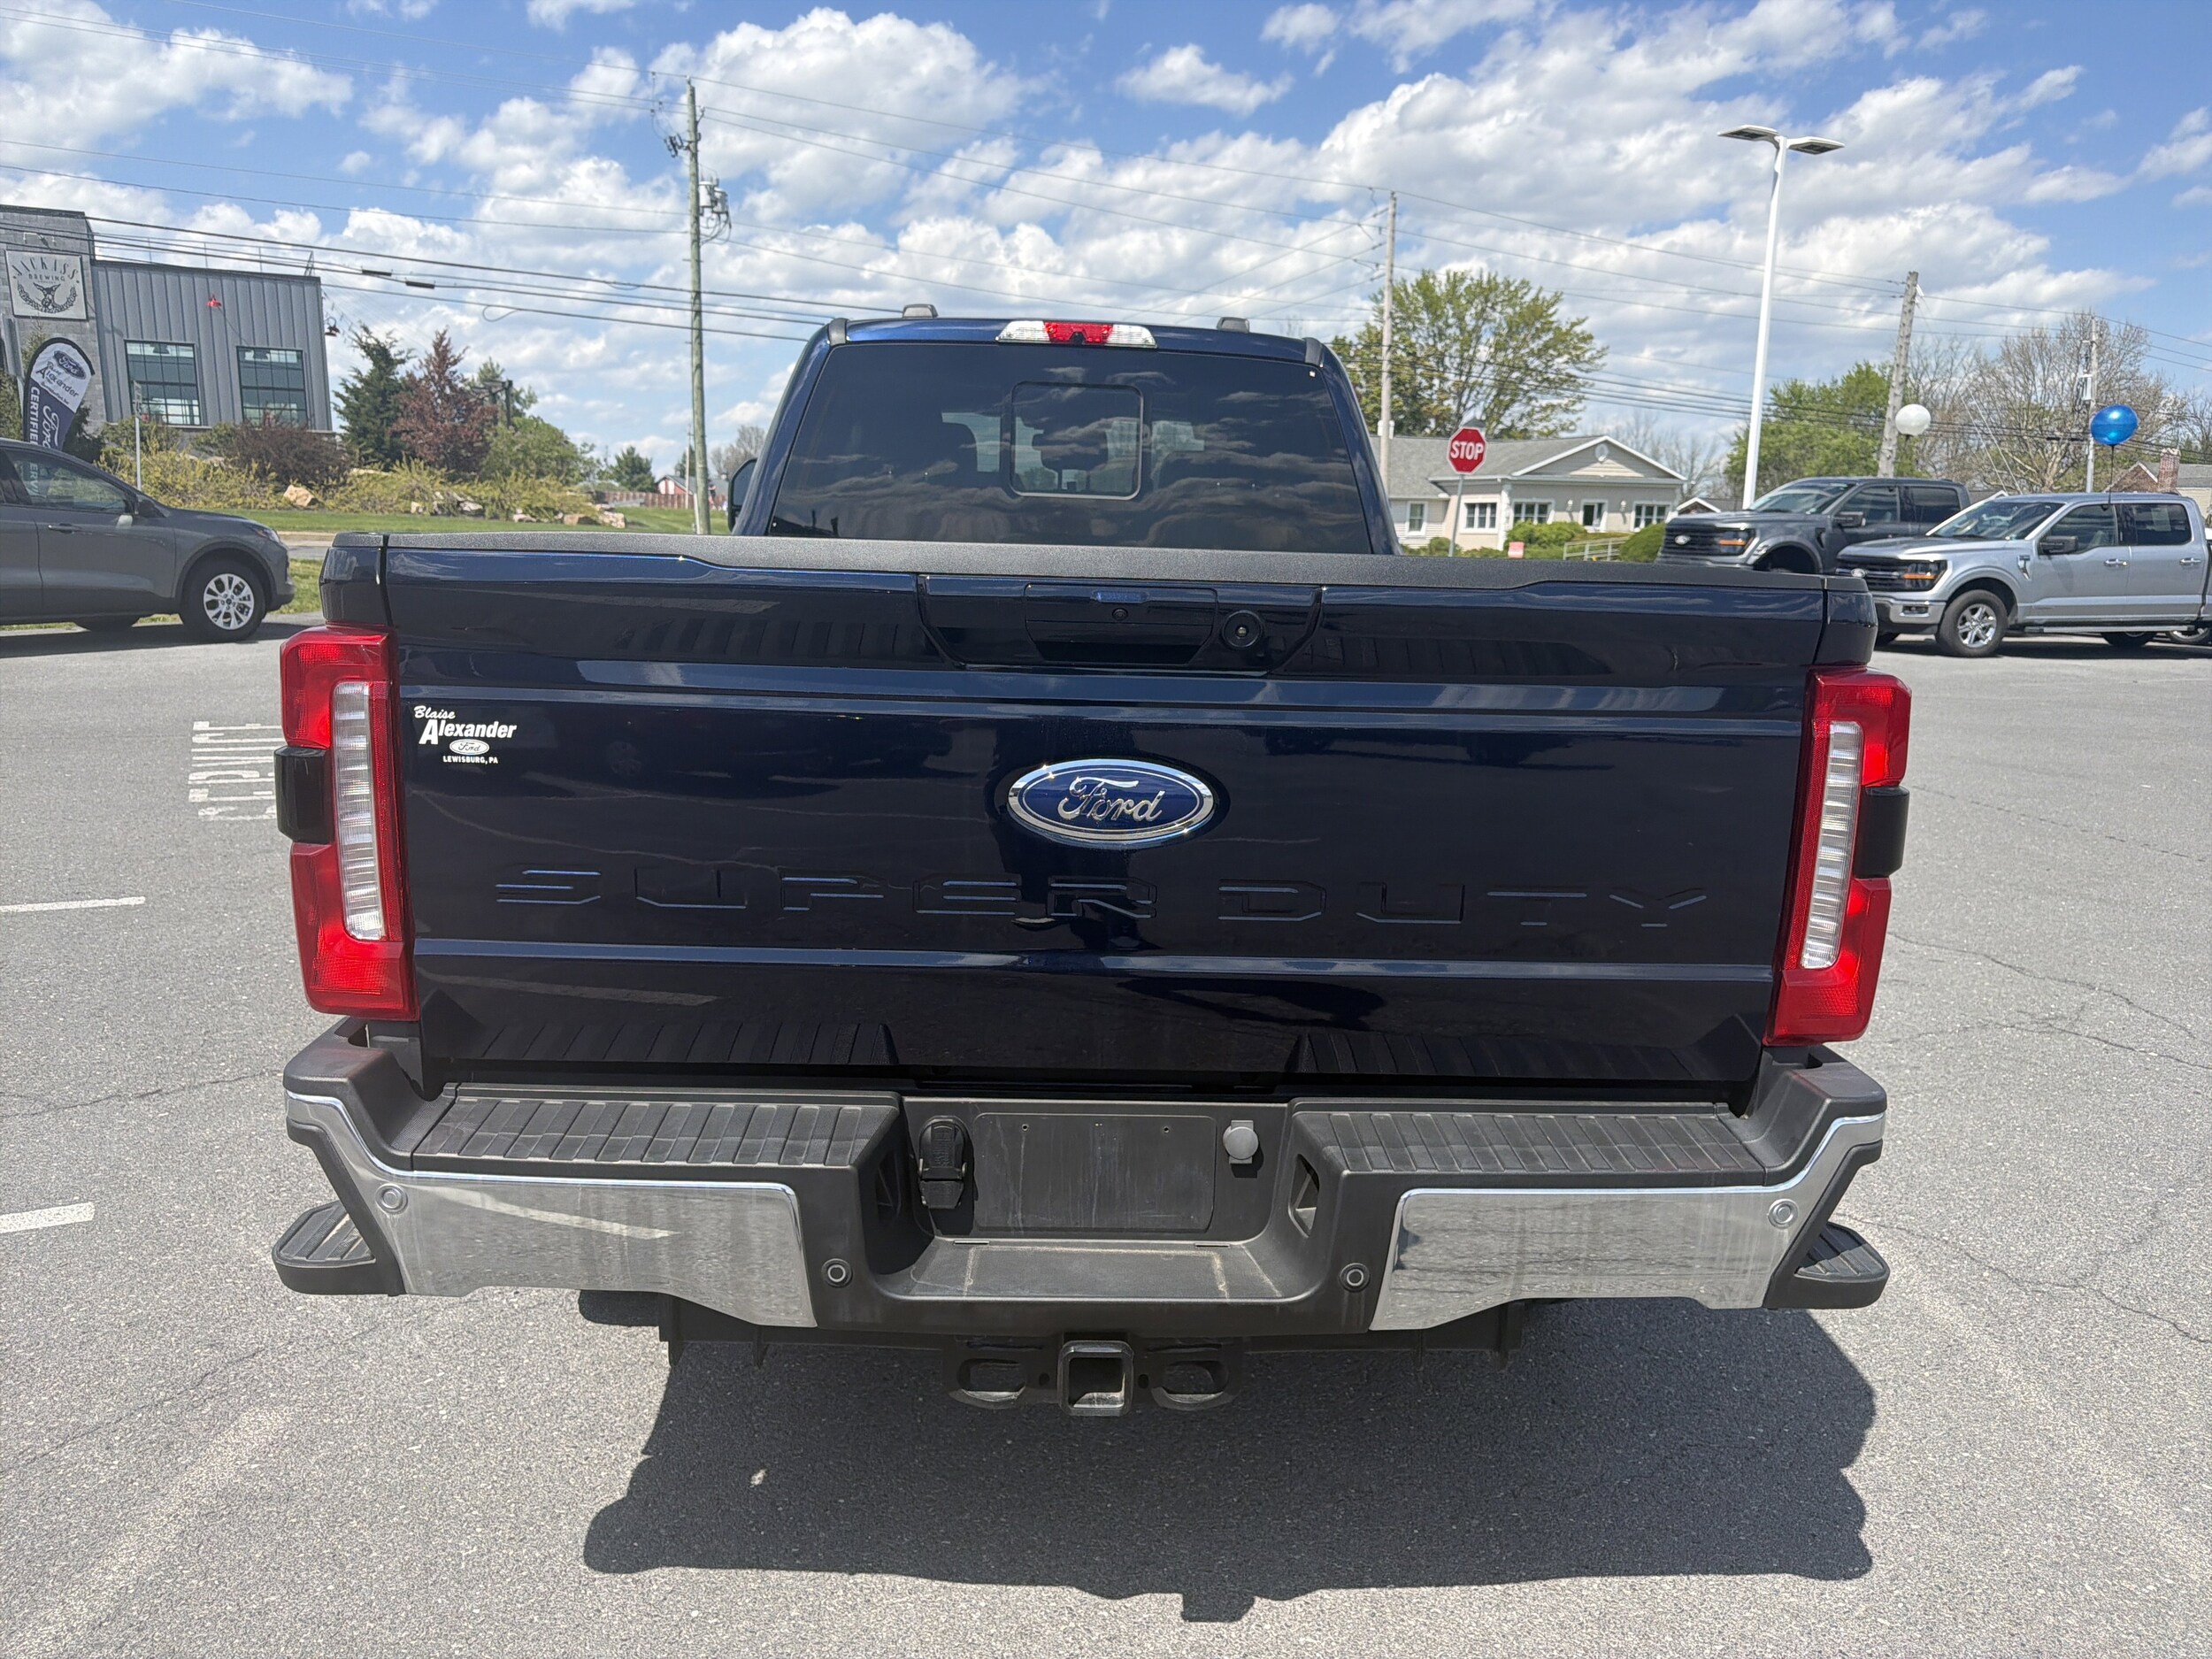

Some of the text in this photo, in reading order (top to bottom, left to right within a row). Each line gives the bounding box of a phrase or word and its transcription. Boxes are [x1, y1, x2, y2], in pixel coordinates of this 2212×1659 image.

[36, 365, 80, 397] Alexander
[1450, 441, 1484, 460] STOP
[413, 705, 456, 719] Blaise
[419, 719, 518, 745] Alexander
[442, 756, 488, 764] LEWISBURG,
[1057, 776, 1166, 822] Ford
[493, 864, 1707, 927] SUPER DUTY
